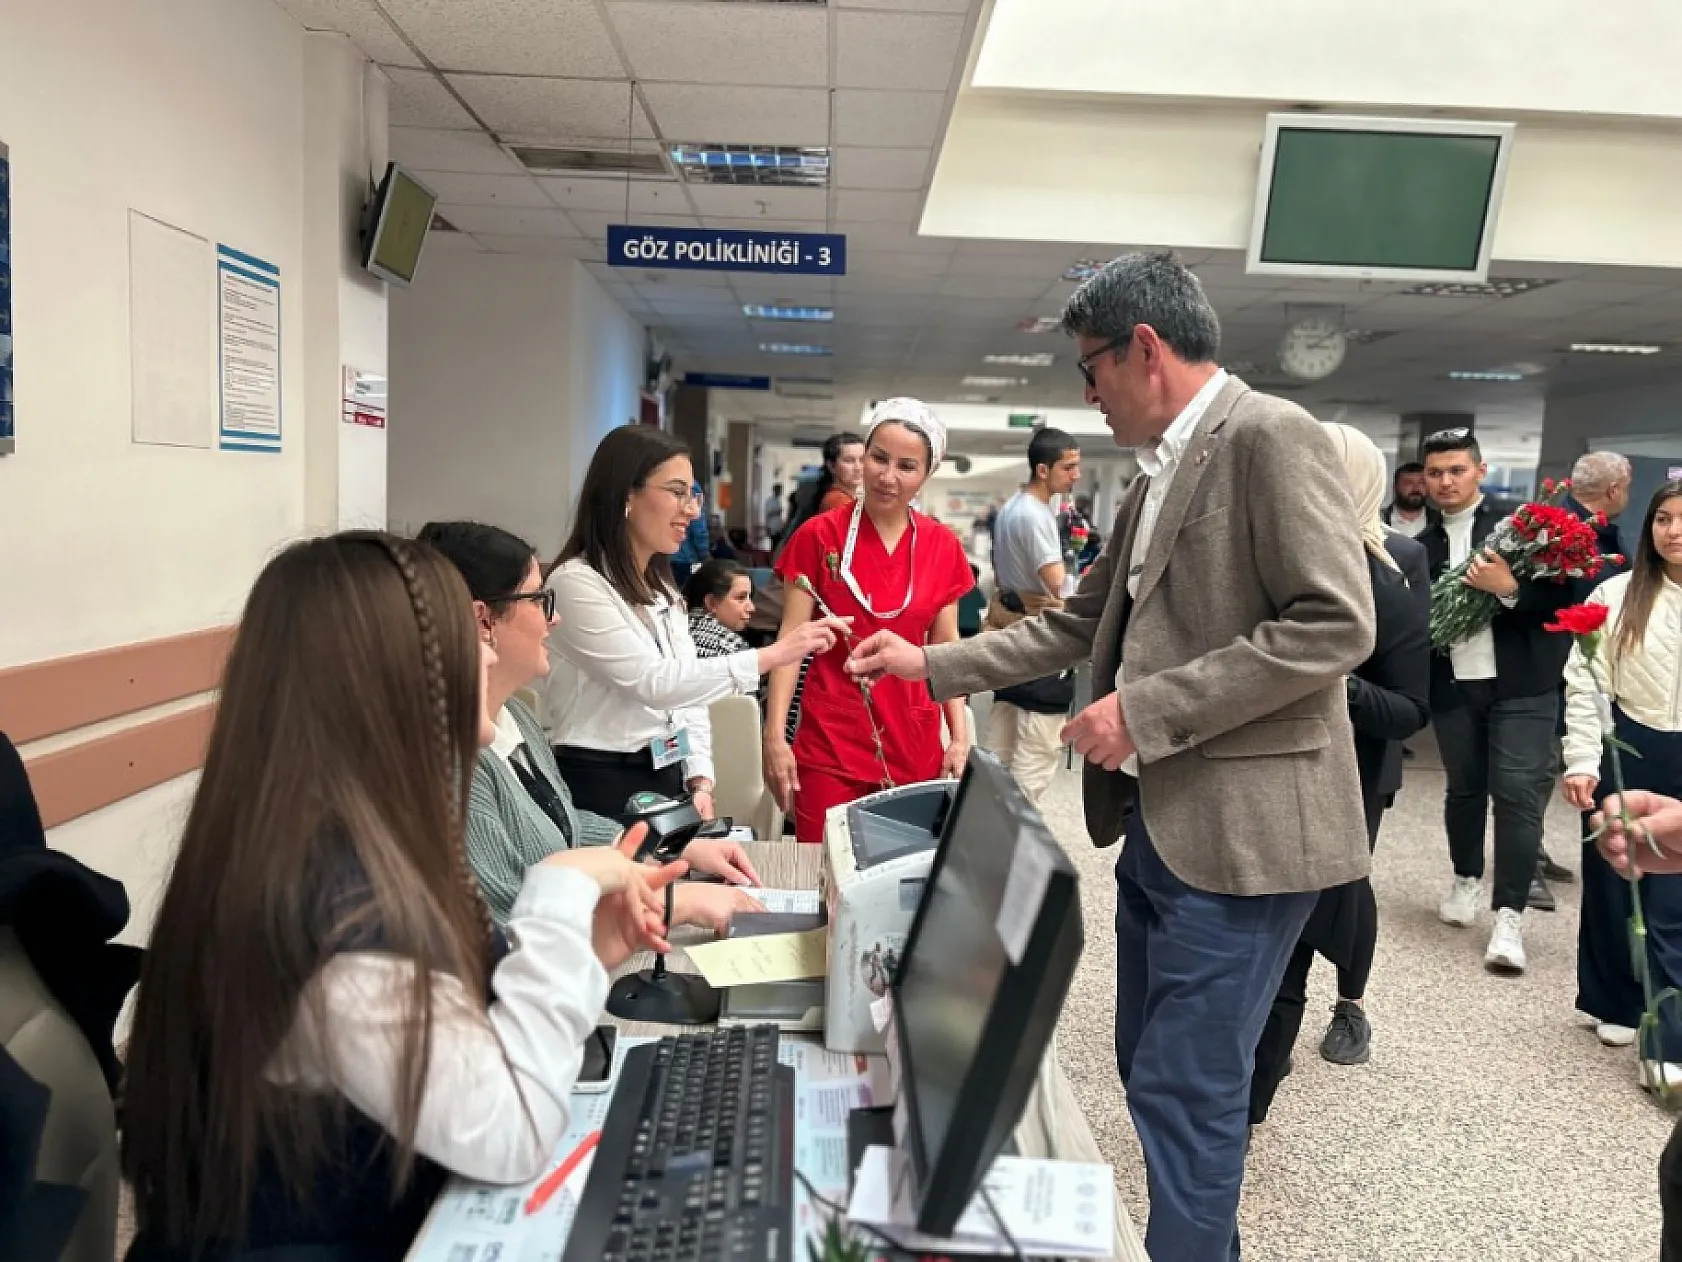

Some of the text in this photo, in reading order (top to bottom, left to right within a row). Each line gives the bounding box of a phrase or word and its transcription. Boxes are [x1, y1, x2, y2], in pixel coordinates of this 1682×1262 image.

[623, 235, 669, 260] GÖZ
[674, 237, 800, 266] POLİKLİNİĞİ
[818, 247, 831, 266] 3
